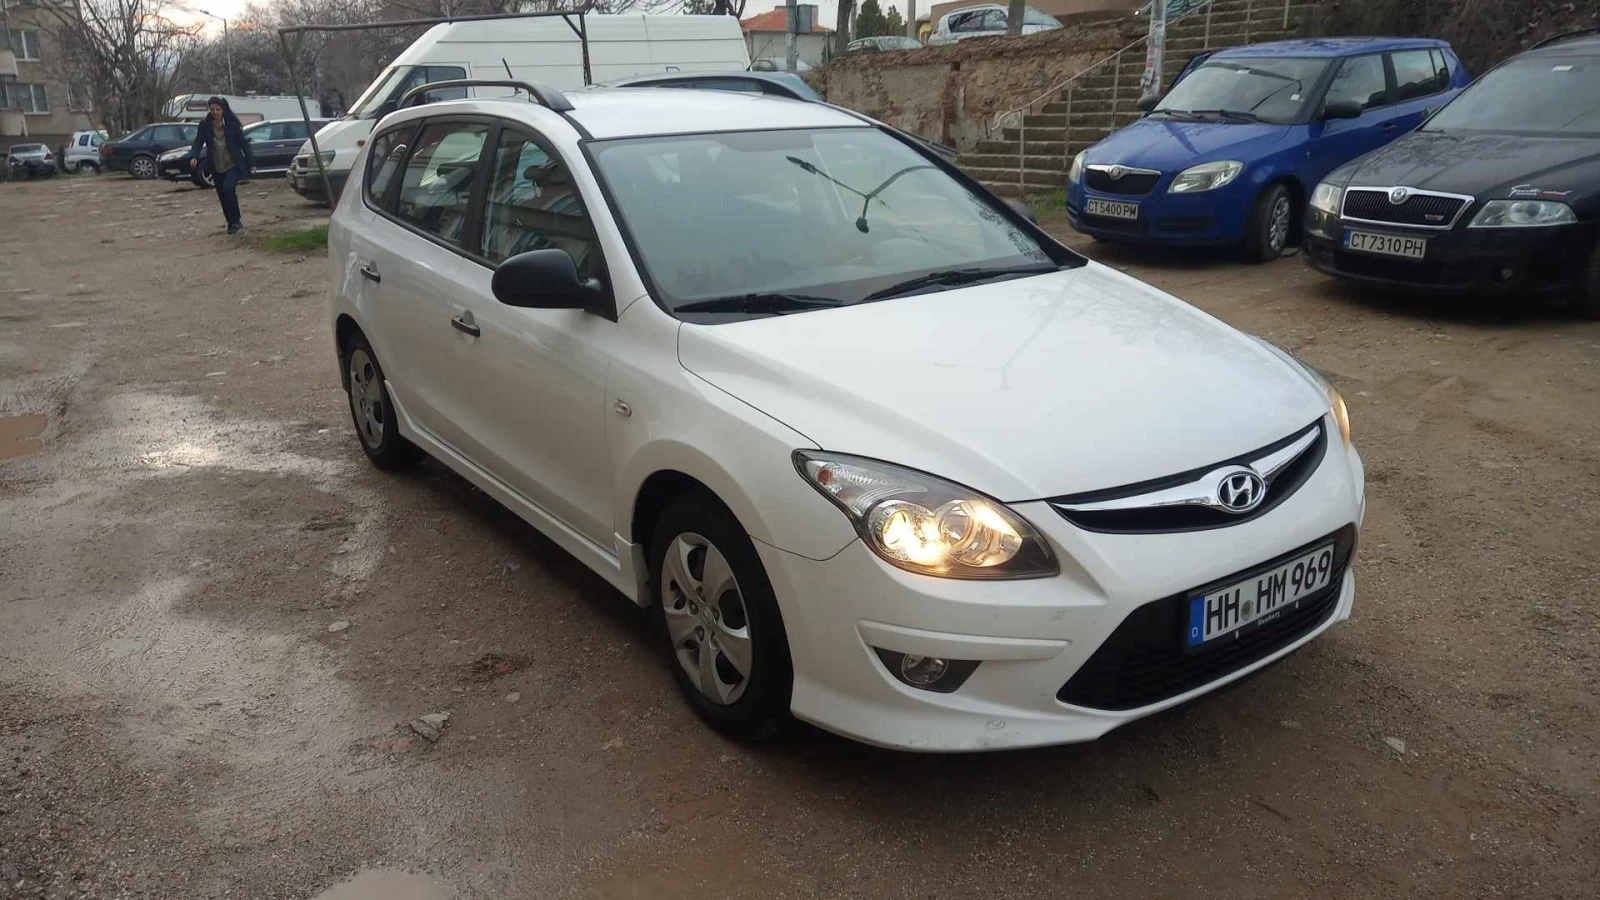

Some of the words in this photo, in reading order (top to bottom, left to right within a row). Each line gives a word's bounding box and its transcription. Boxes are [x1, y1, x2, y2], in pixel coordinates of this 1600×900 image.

[1100, 202, 1122, 215] 5400
[1351, 233, 1368, 248] CT
[1369, 236, 1402, 252] 7310
[1403, 240, 1423, 255] PH
[1206, 588, 1241, 635] HH
[1256, 569, 1288, 613] HM
[1291, 550, 1331, 596] 969
[1191, 627, 1199, 637] D
